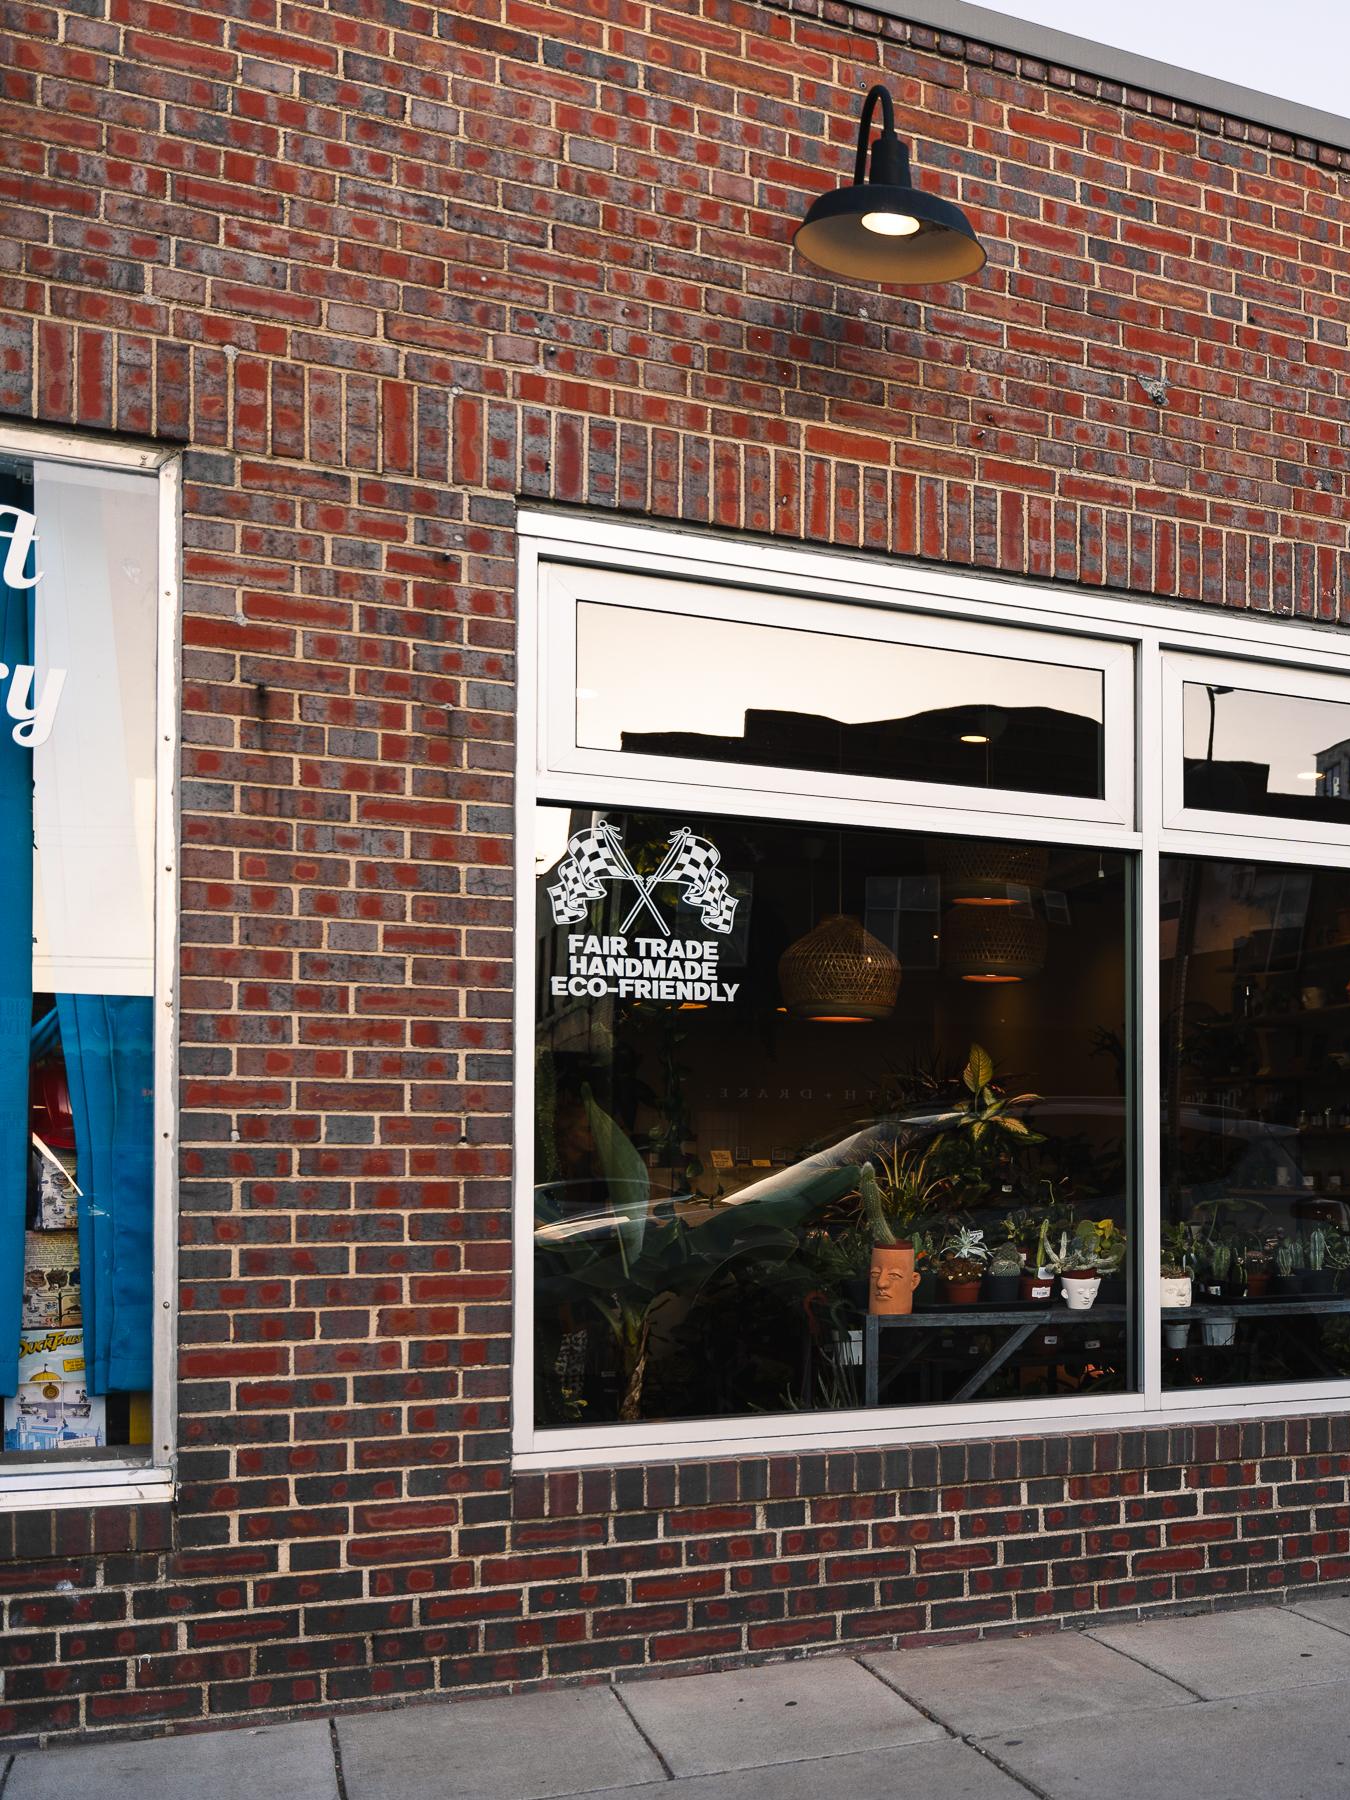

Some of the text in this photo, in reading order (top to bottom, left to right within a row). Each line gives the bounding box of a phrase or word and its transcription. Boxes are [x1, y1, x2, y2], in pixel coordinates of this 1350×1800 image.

[568, 934, 718, 959] FAIR TRADE
[569, 955, 718, 981] HANDMADE
[551, 976, 740, 1002] ECO-FRIENDLY
